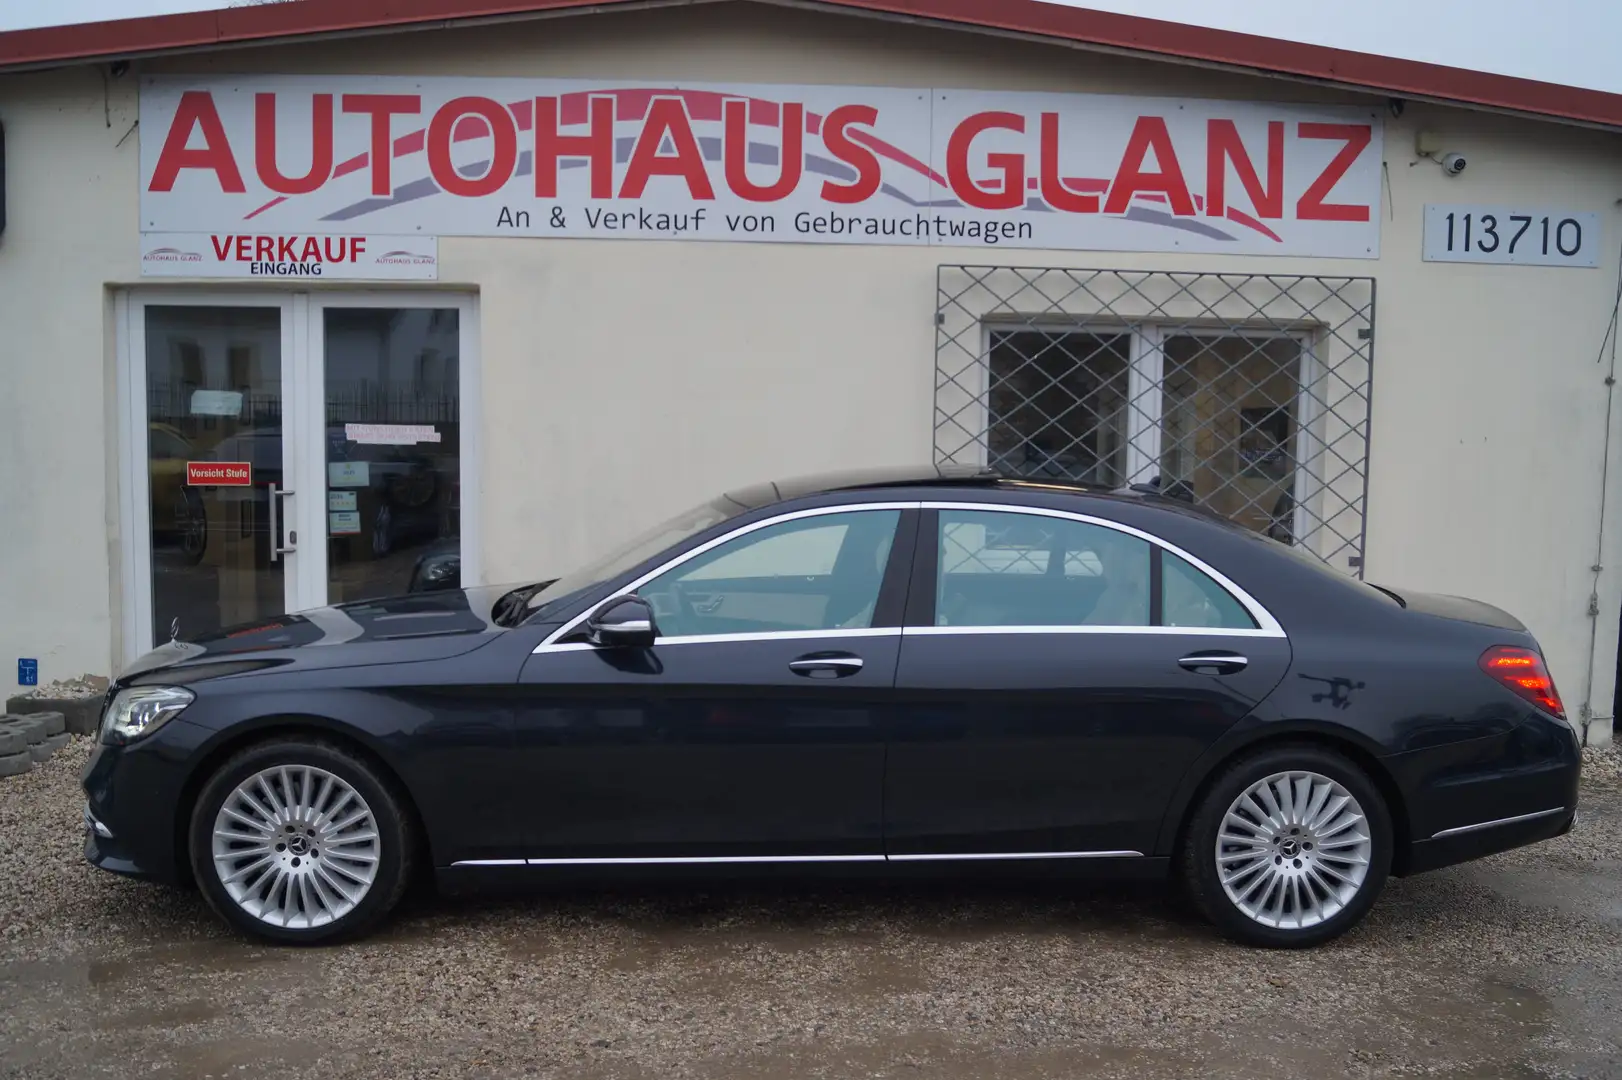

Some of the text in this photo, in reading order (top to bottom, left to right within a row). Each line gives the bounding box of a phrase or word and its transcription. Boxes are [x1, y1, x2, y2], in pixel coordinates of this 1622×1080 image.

[148, 91, 1372, 223] AUTOHAUS GLANZ
[496, 206, 1033, 243] An & Verkauf von Gebrauchtwagen
[1445, 212, 1582, 256] 113710
[210, 234, 366, 263] VERKAUF
[250, 263, 322, 275] EINGANG
[191, 468, 247, 478] Vorsicht Stufe
